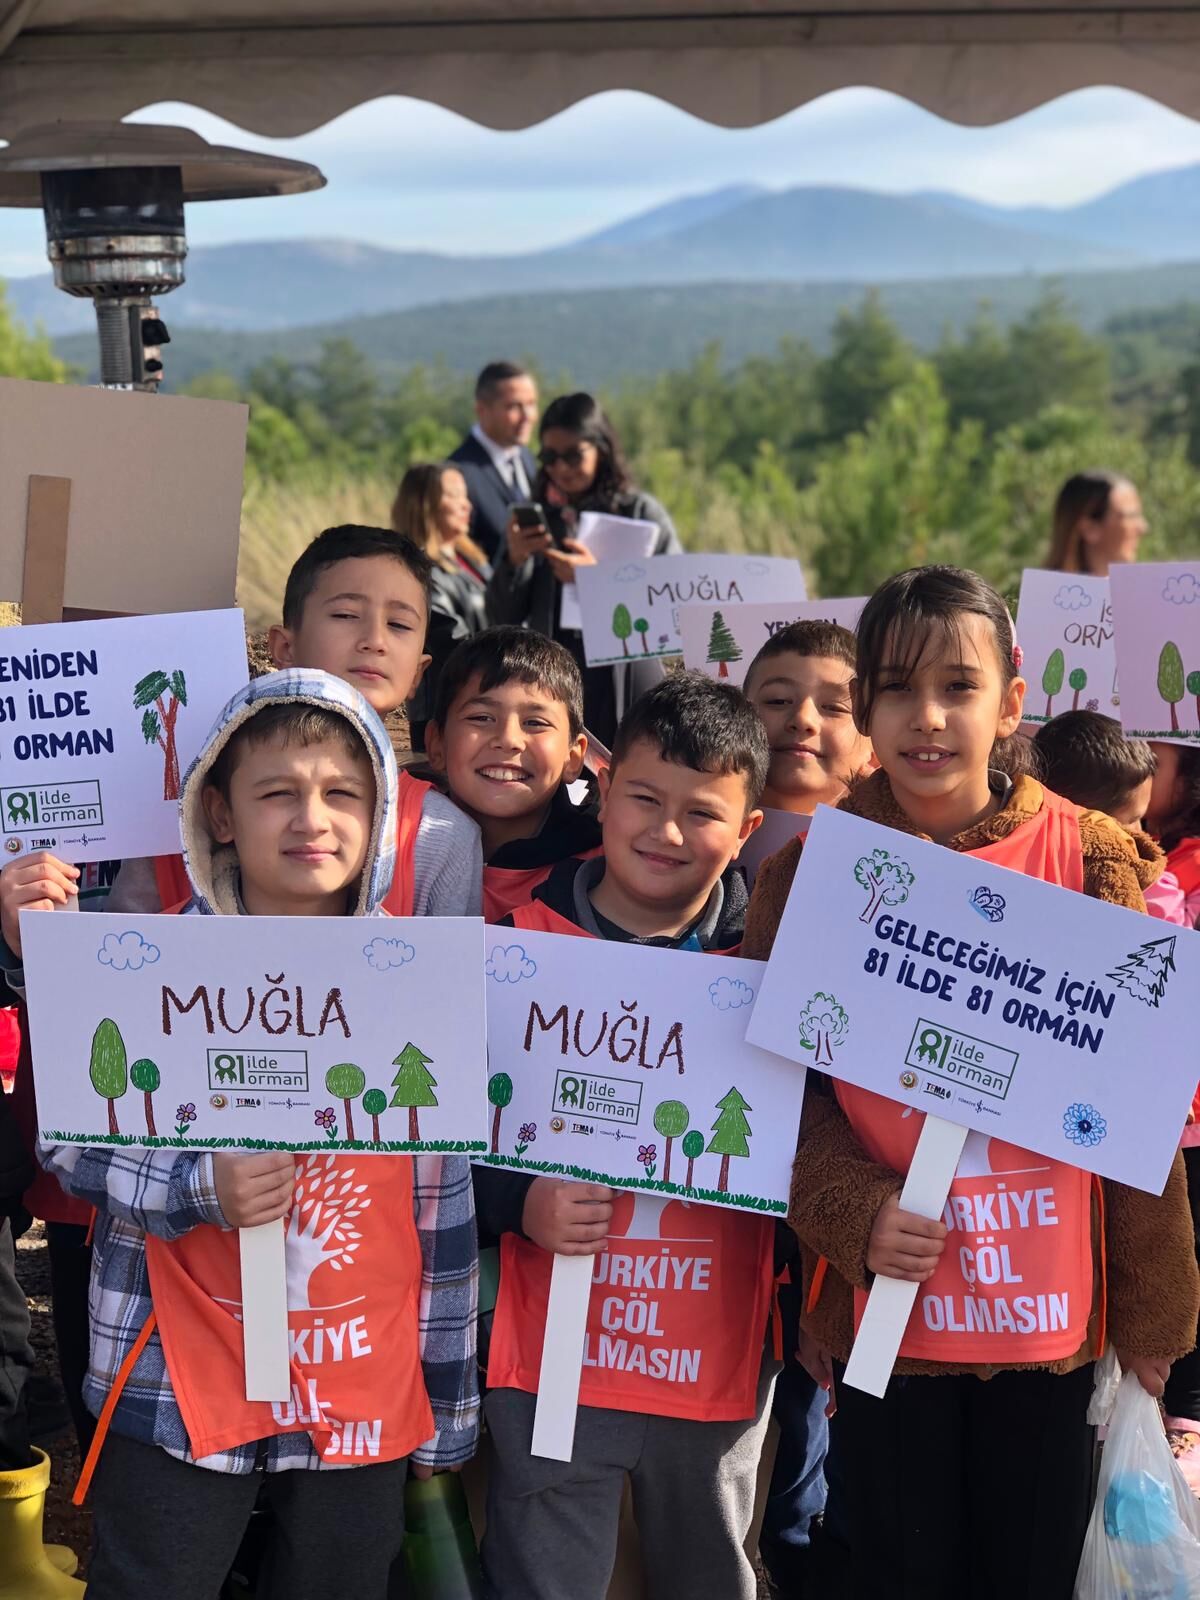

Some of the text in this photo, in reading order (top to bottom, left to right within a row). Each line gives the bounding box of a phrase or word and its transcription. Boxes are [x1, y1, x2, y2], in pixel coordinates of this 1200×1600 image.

[647, 575, 744, 606] MUĞLA
[1063, 622, 1114, 649] ORM
[0, 648, 98, 682] ENİDEN
[28, 688, 91, 720] İLDE
[13, 727, 114, 760] ORMAN
[40, 789, 71, 805] ilde
[42, 808, 97, 823] orman
[31, 838, 51, 847] TEMA
[76, 859, 122, 888] TEM
[874, 913, 1116, 1019] GELECEĞİMİZ İÇİN
[161, 972, 352, 1038] MUĞLA
[863, 947, 1104, 1054] 81 İLDE 81 ORMAN
[523, 1000, 685, 1075] MUĞLA
[952, 1039, 985, 1064] ilde
[247, 1055, 278, 1069] ilde
[946, 1061, 1003, 1091] orman
[248, 1073, 303, 1086] orman
[588, 1080, 616, 1098] ilde
[926, 1082, 946, 1097] TEMA
[236, 1098, 256, 1106] TEMA
[586, 1101, 635, 1118] orman
[959, 1236, 1024, 1293] ÇÖL
[601, 1292, 665, 1337] ÇÖL
[922, 1292, 1069, 1334] OLMASIN
[288, 1315, 372, 1364] KİYE
[582, 1332, 702, 1383] LMASIN
